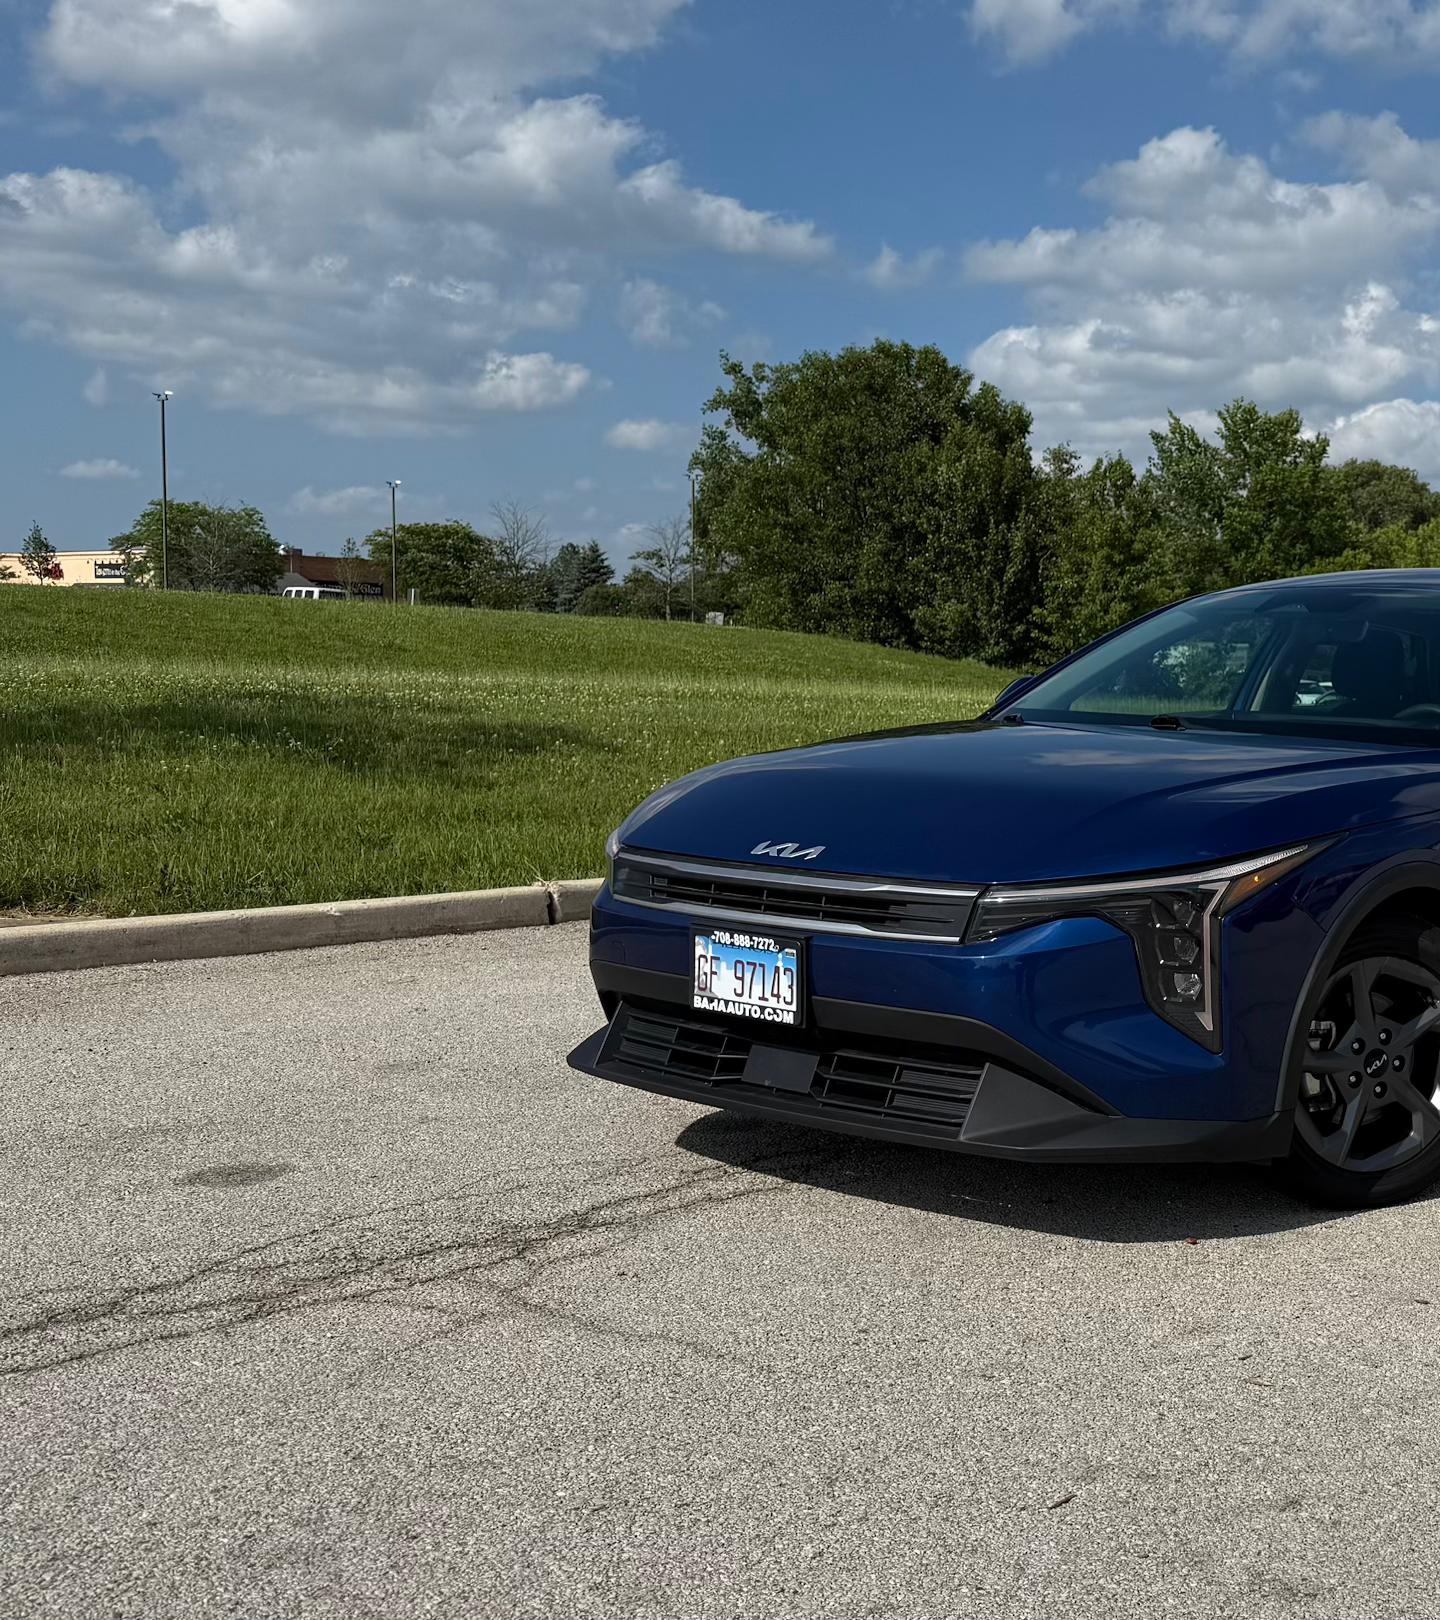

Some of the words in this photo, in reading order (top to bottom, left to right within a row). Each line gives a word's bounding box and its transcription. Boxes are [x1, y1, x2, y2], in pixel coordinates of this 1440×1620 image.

[697, 954, 721, 993] GF
[733, 959, 794, 1006] 97143
[693, 996, 794, 1025] BAJAAUTO.COM
